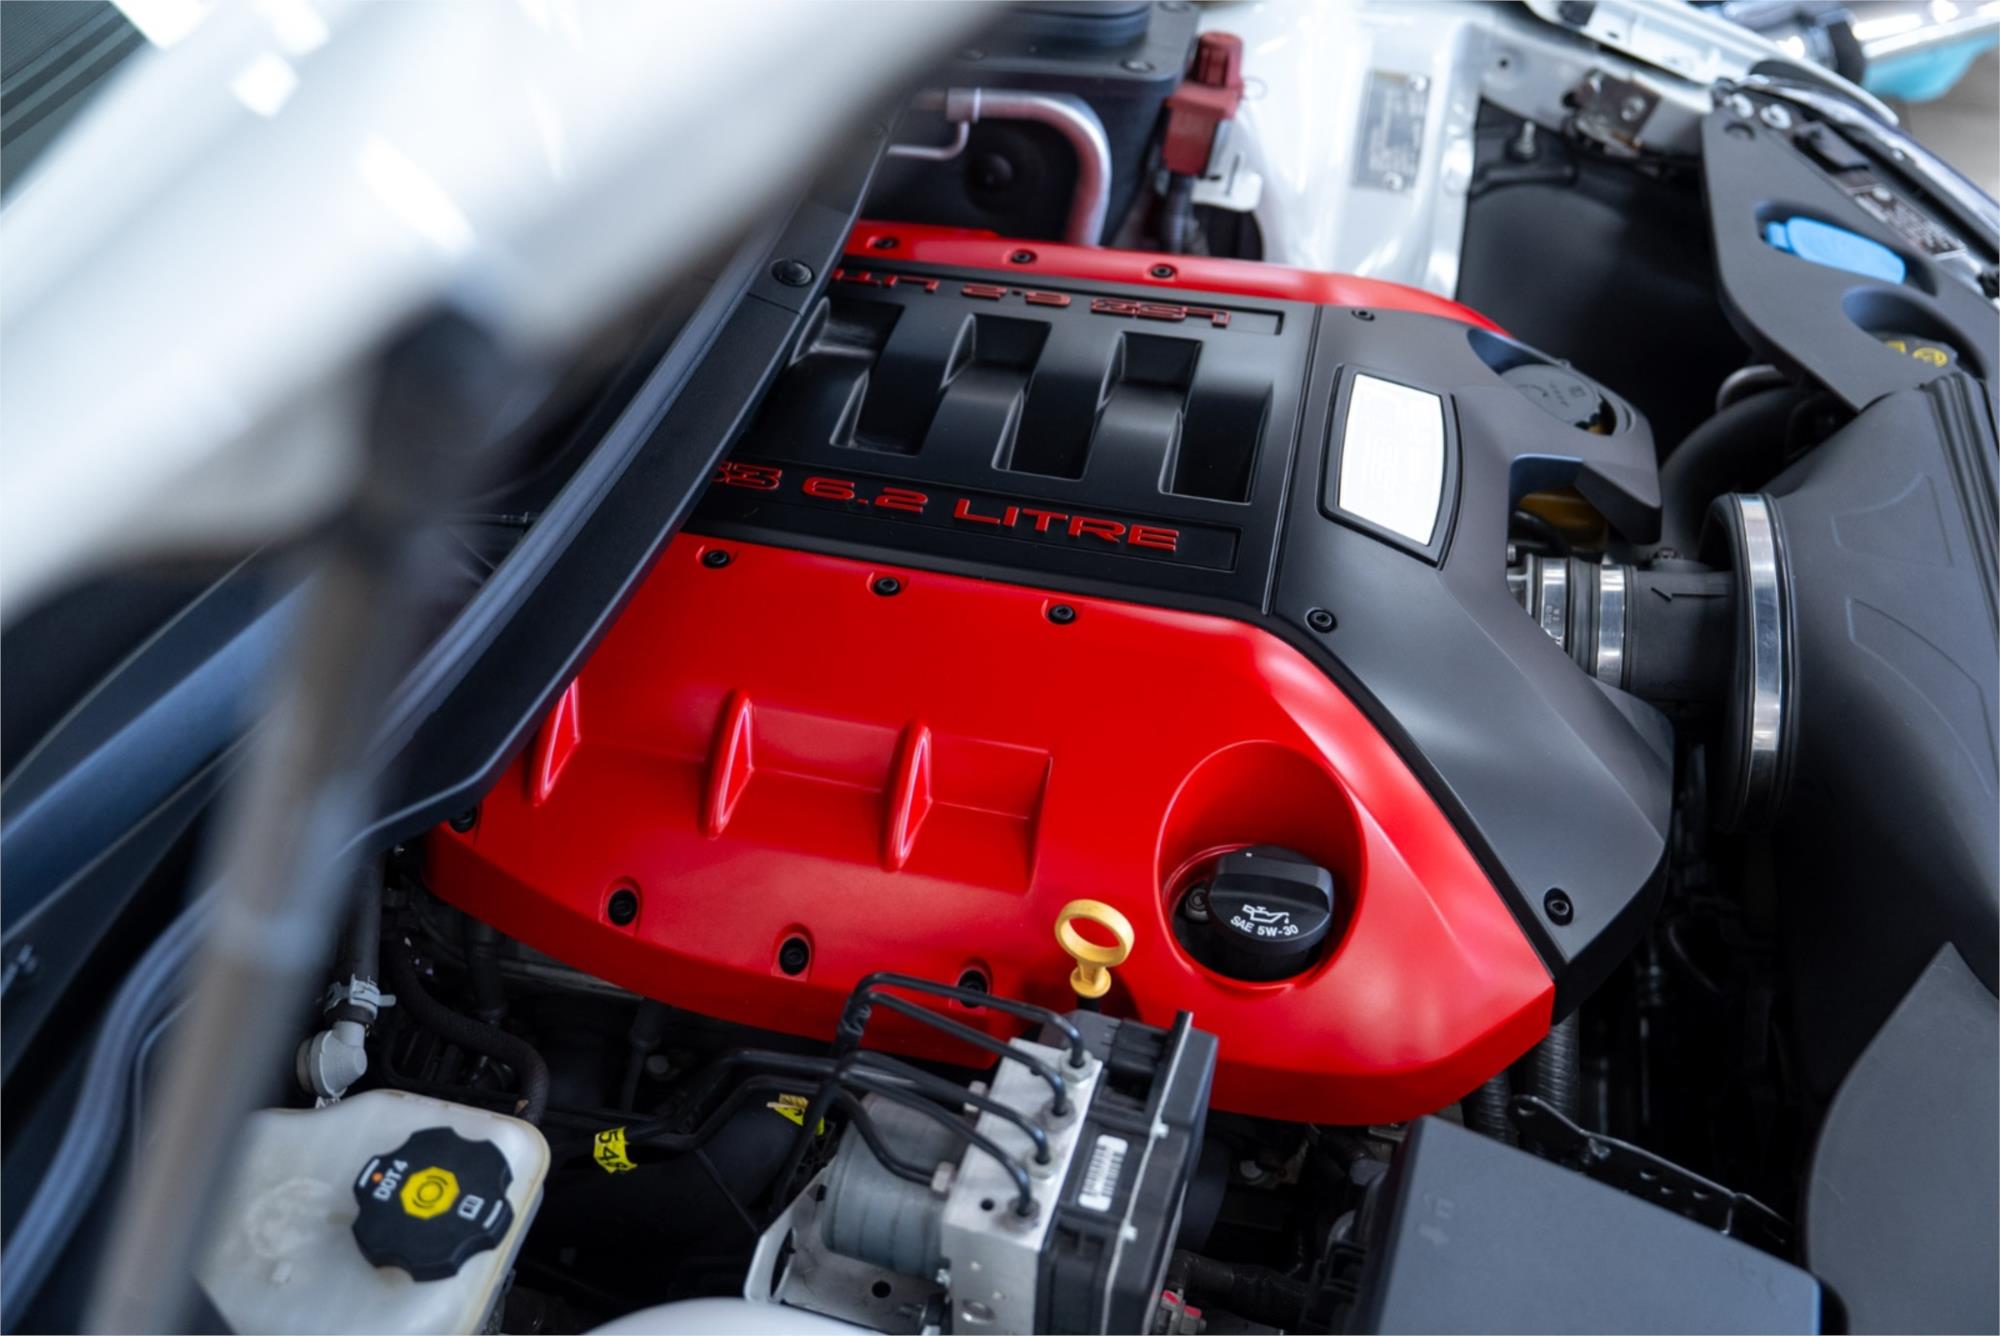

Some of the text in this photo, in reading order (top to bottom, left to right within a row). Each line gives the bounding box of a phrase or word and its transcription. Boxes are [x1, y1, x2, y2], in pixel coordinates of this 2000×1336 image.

[802, 475, 928, 513] 6.2
[952, 497, 1180, 553] LITRE
[1230, 915, 1299, 937] SAE 5W-30
